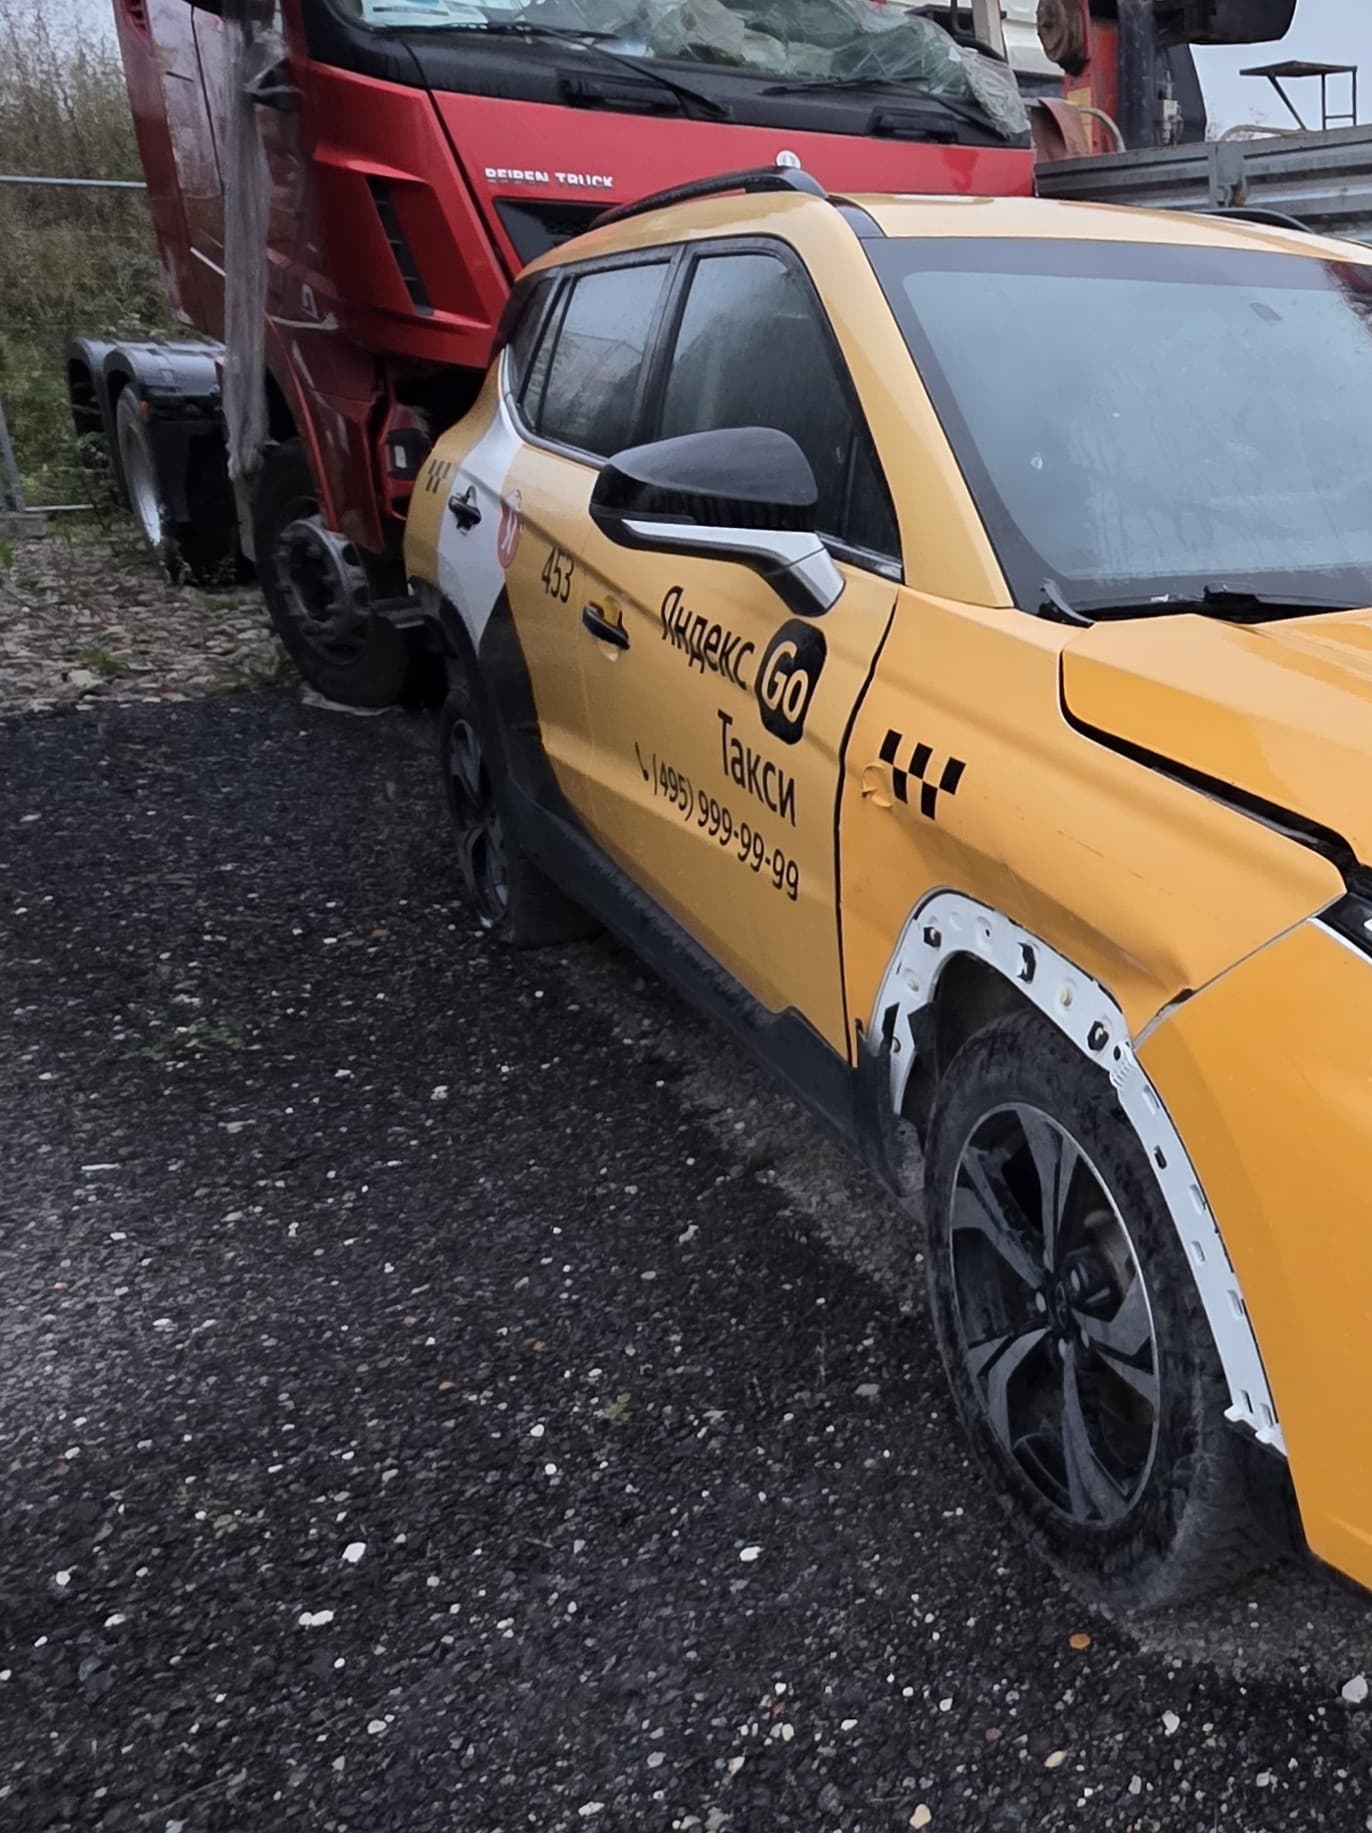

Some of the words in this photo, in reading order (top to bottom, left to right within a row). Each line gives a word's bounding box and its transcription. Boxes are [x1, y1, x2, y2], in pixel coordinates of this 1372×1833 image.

[555, 172, 613, 188] TRUCK
[541, 544, 575, 603] 453
[661, 585, 755, 691] Яндекс
[761, 640, 809, 723] Go
[652, 752, 694, 822] (495)
[697, 789, 800, 901] 999-99-99
[717, 708, 796, 828] Такси
